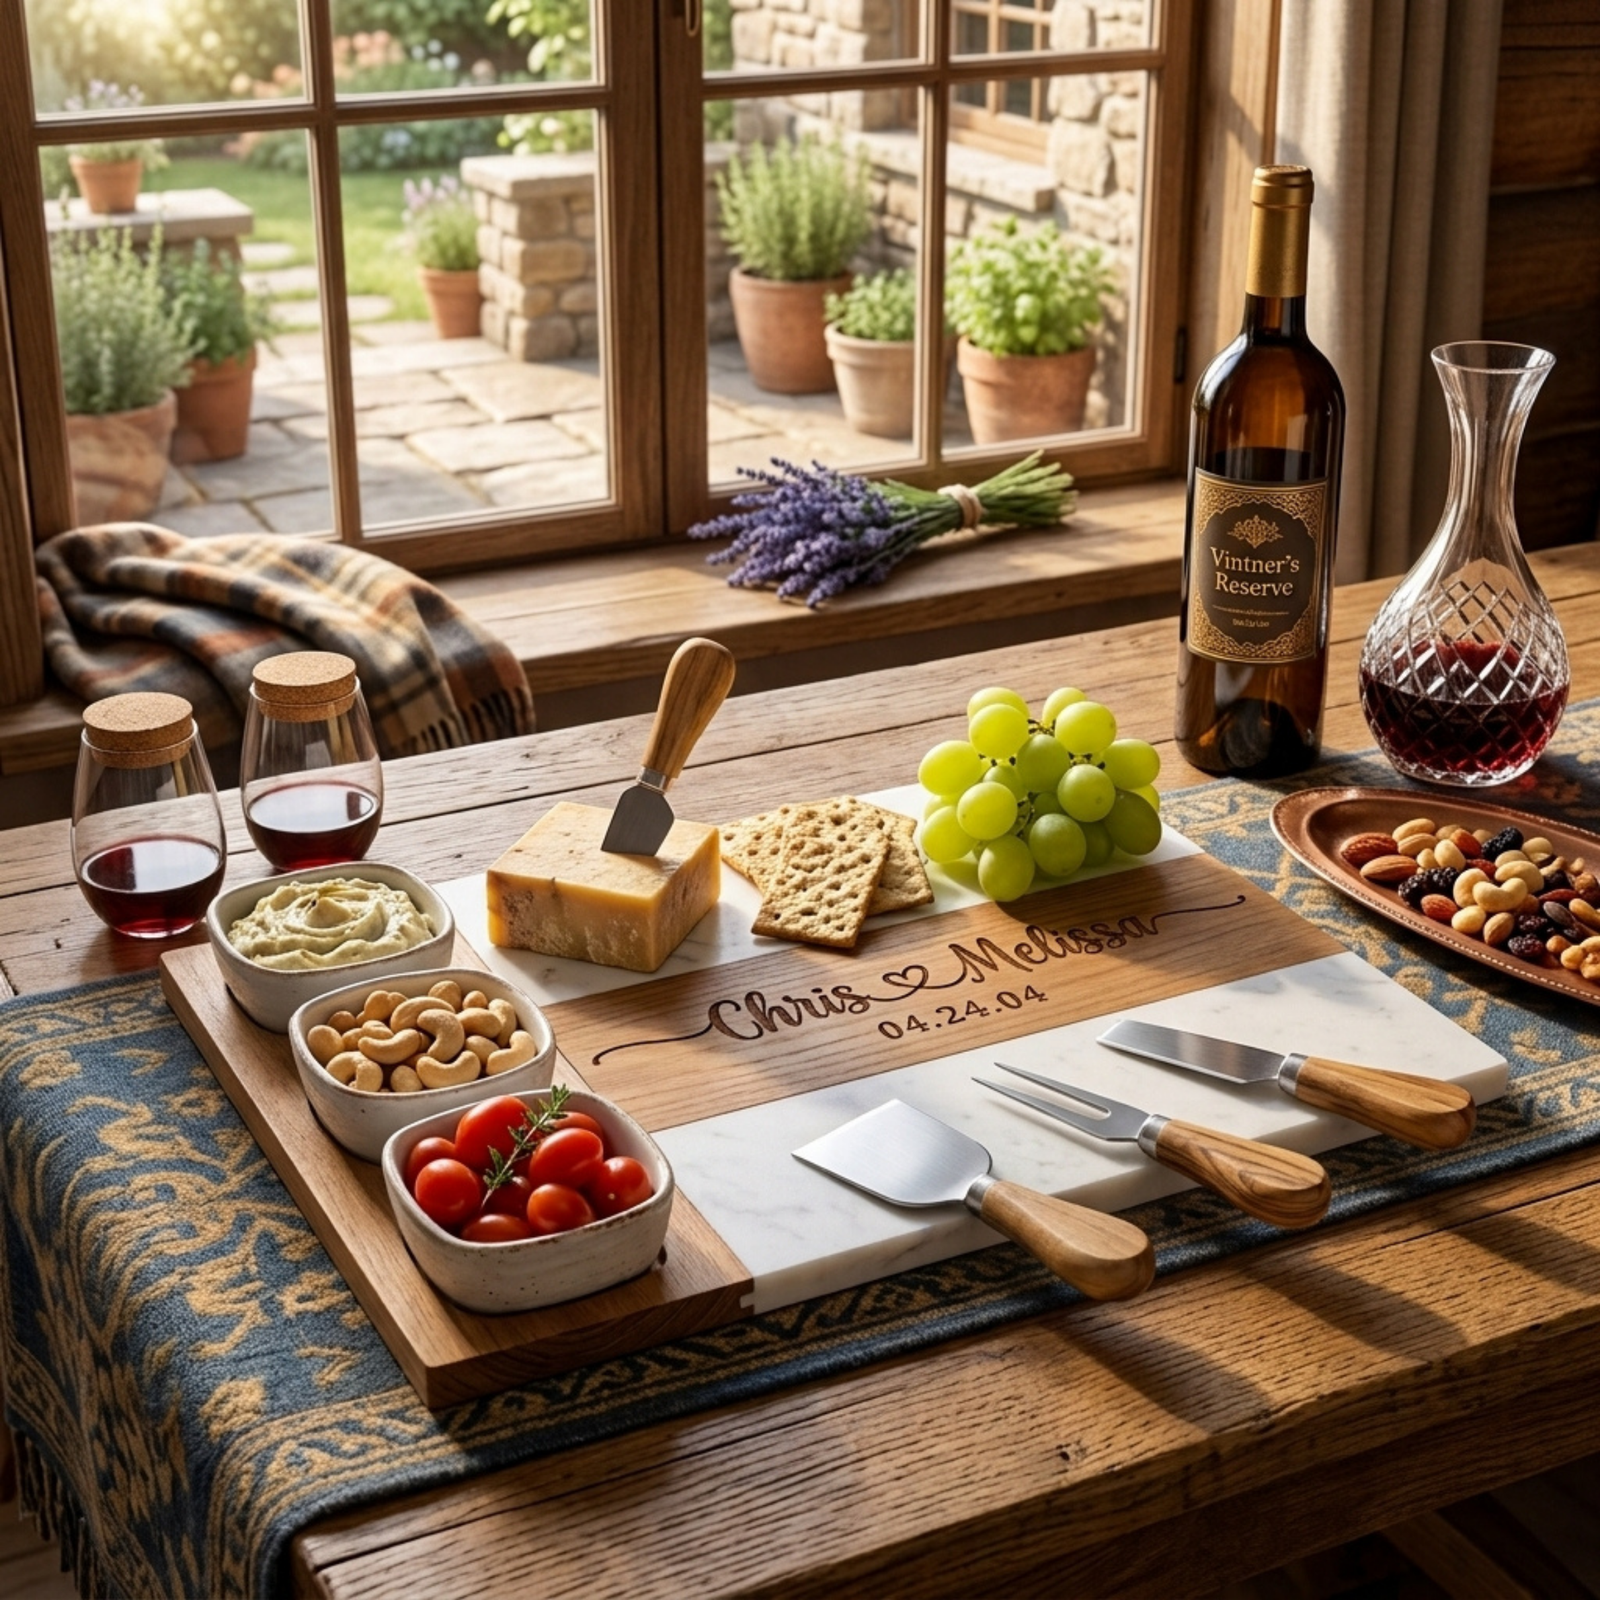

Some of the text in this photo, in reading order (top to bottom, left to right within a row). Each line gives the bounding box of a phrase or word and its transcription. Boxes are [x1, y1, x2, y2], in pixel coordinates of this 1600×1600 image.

[1210, 547, 1300, 573] Vintner's
[1215, 571, 1293, 596] Reserve
[706, 914, 1158, 1040] Chris Melissa
[878, 984, 1048, 1040] 04.24.04
